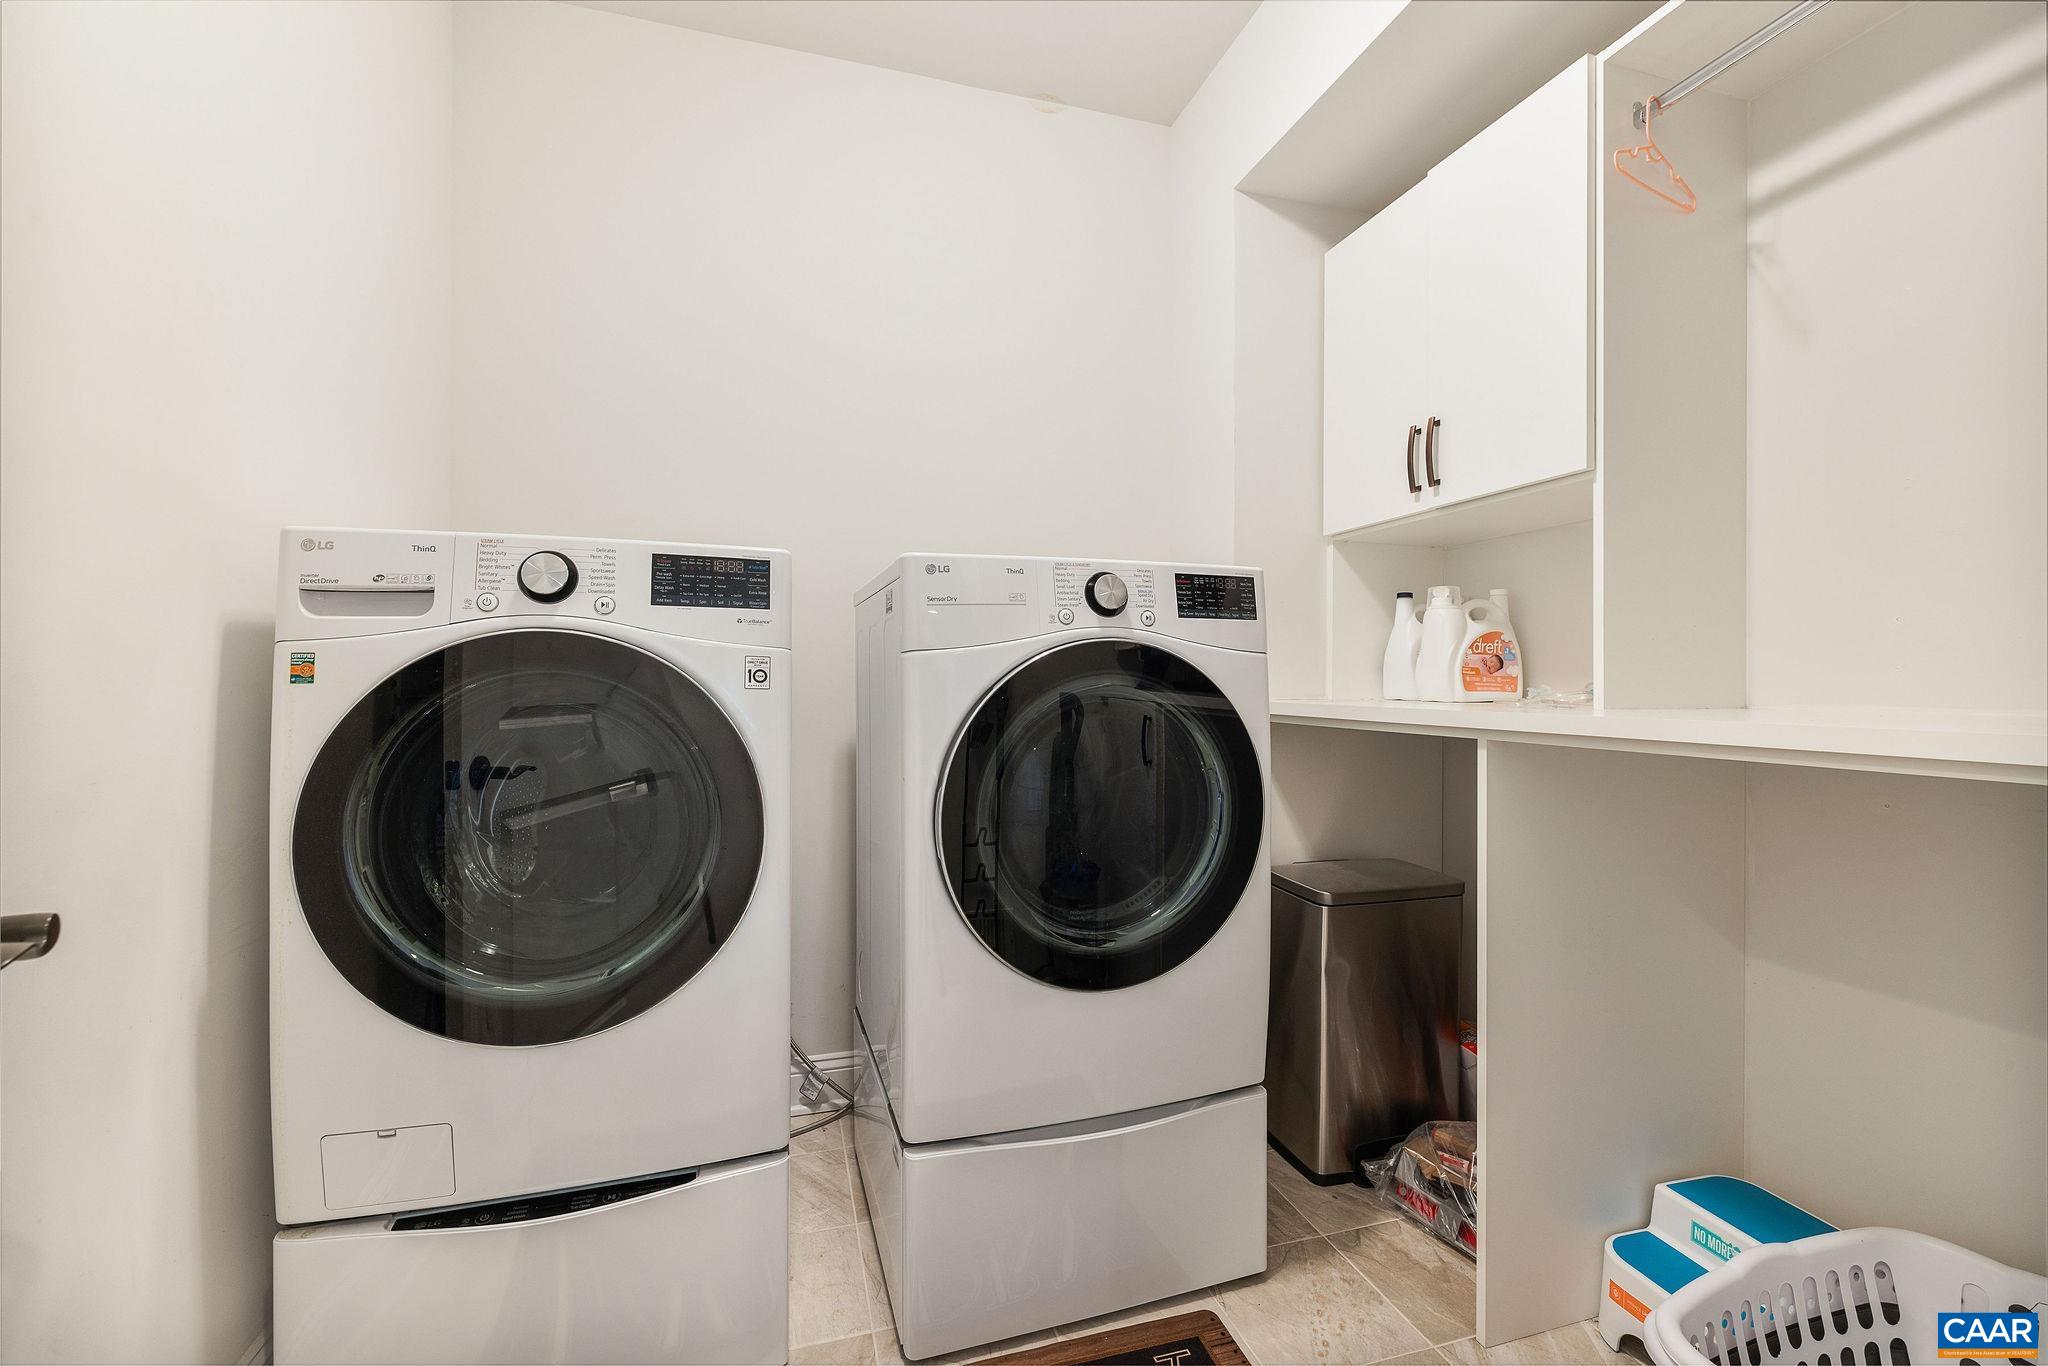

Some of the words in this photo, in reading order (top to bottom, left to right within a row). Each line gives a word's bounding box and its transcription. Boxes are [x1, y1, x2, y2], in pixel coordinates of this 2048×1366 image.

[317, 541, 334, 550] LG
[1473, 638, 1503, 654] dreft
[747, 668, 768, 684] 10
[1694, 1226, 1706, 1244] NO
